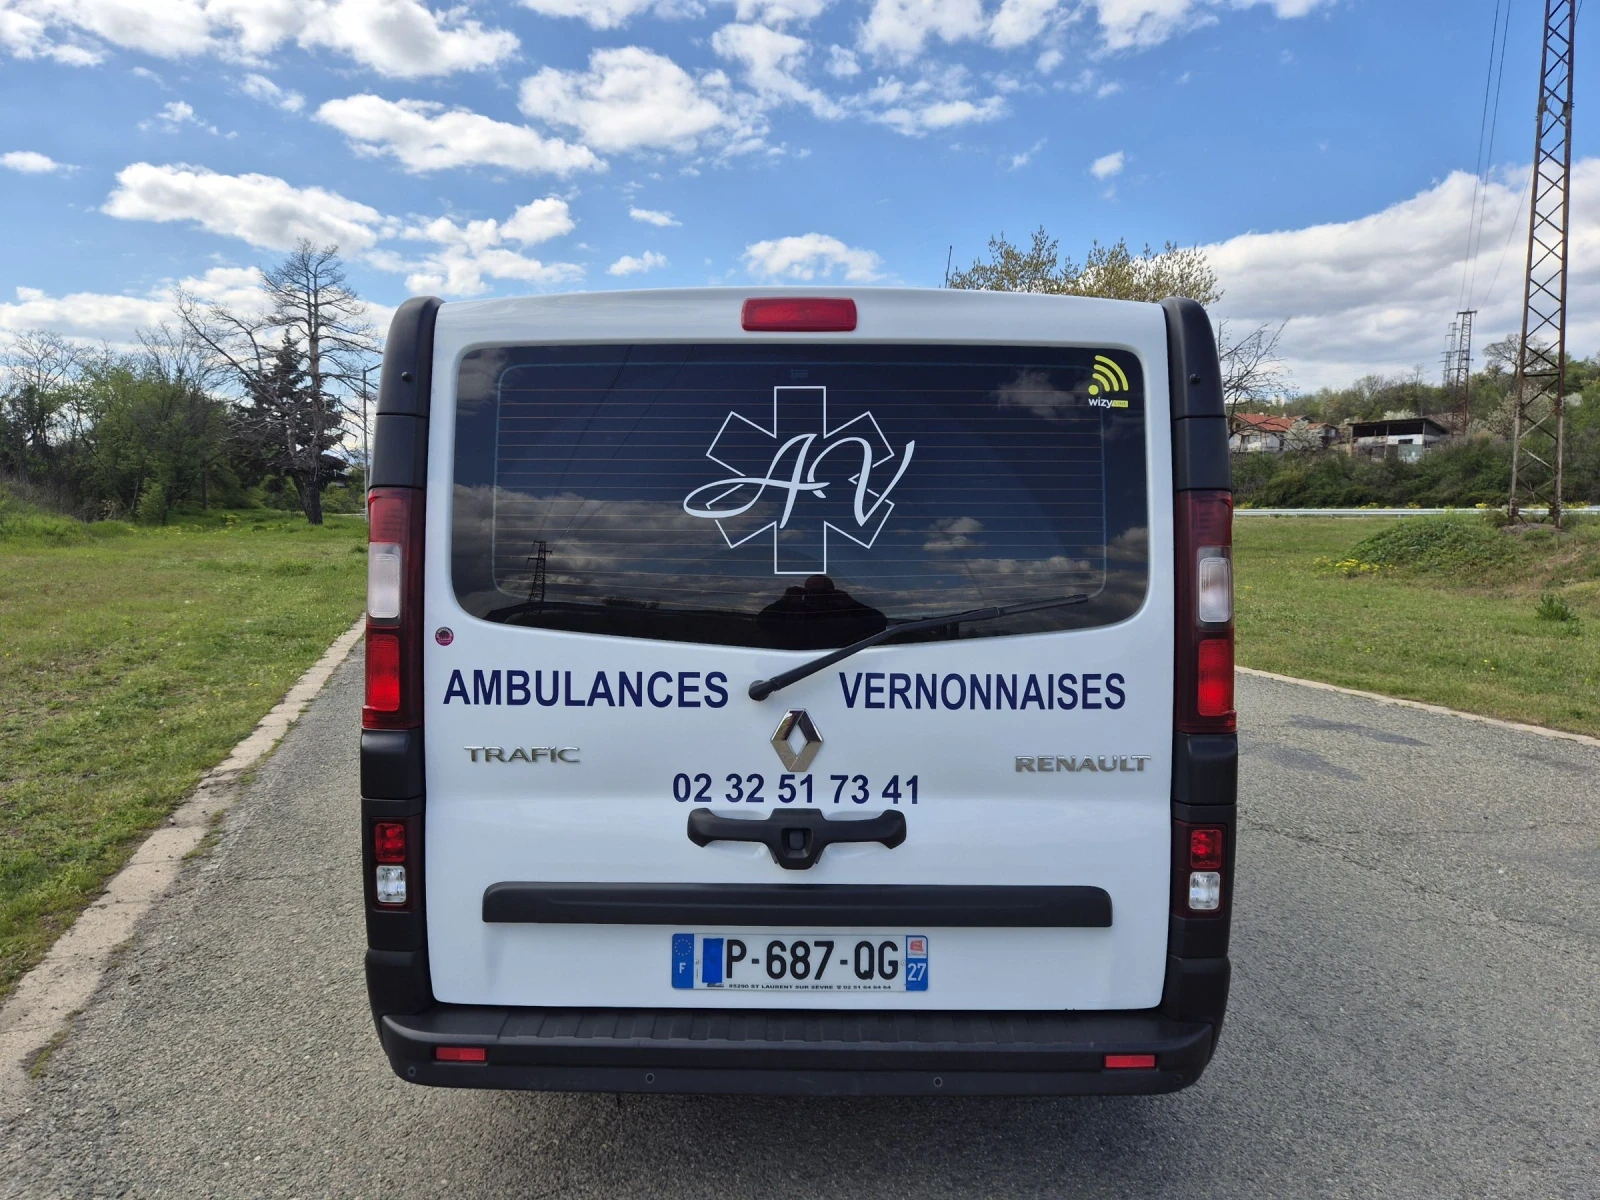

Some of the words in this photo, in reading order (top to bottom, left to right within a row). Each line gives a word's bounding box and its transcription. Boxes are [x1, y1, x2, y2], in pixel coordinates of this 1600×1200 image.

[1088, 397, 1112, 408] wizy
[443, 669, 729, 708] AMBULANCES
[839, 672, 1126, 710] VERNONNAISES
[464, 746, 580, 763] TRAFIC
[1015, 755, 1151, 773] RENAULT
[673, 773, 712, 803] 02
[725, 773, 765, 803] 32
[778, 774, 812, 803] 51
[830, 774, 870, 804] 73
[882, 775, 918, 804] 41
[679, 962, 687, 974] F
[702, 938, 898, 980] P-687-QG
[907, 962, 927, 981] 27
